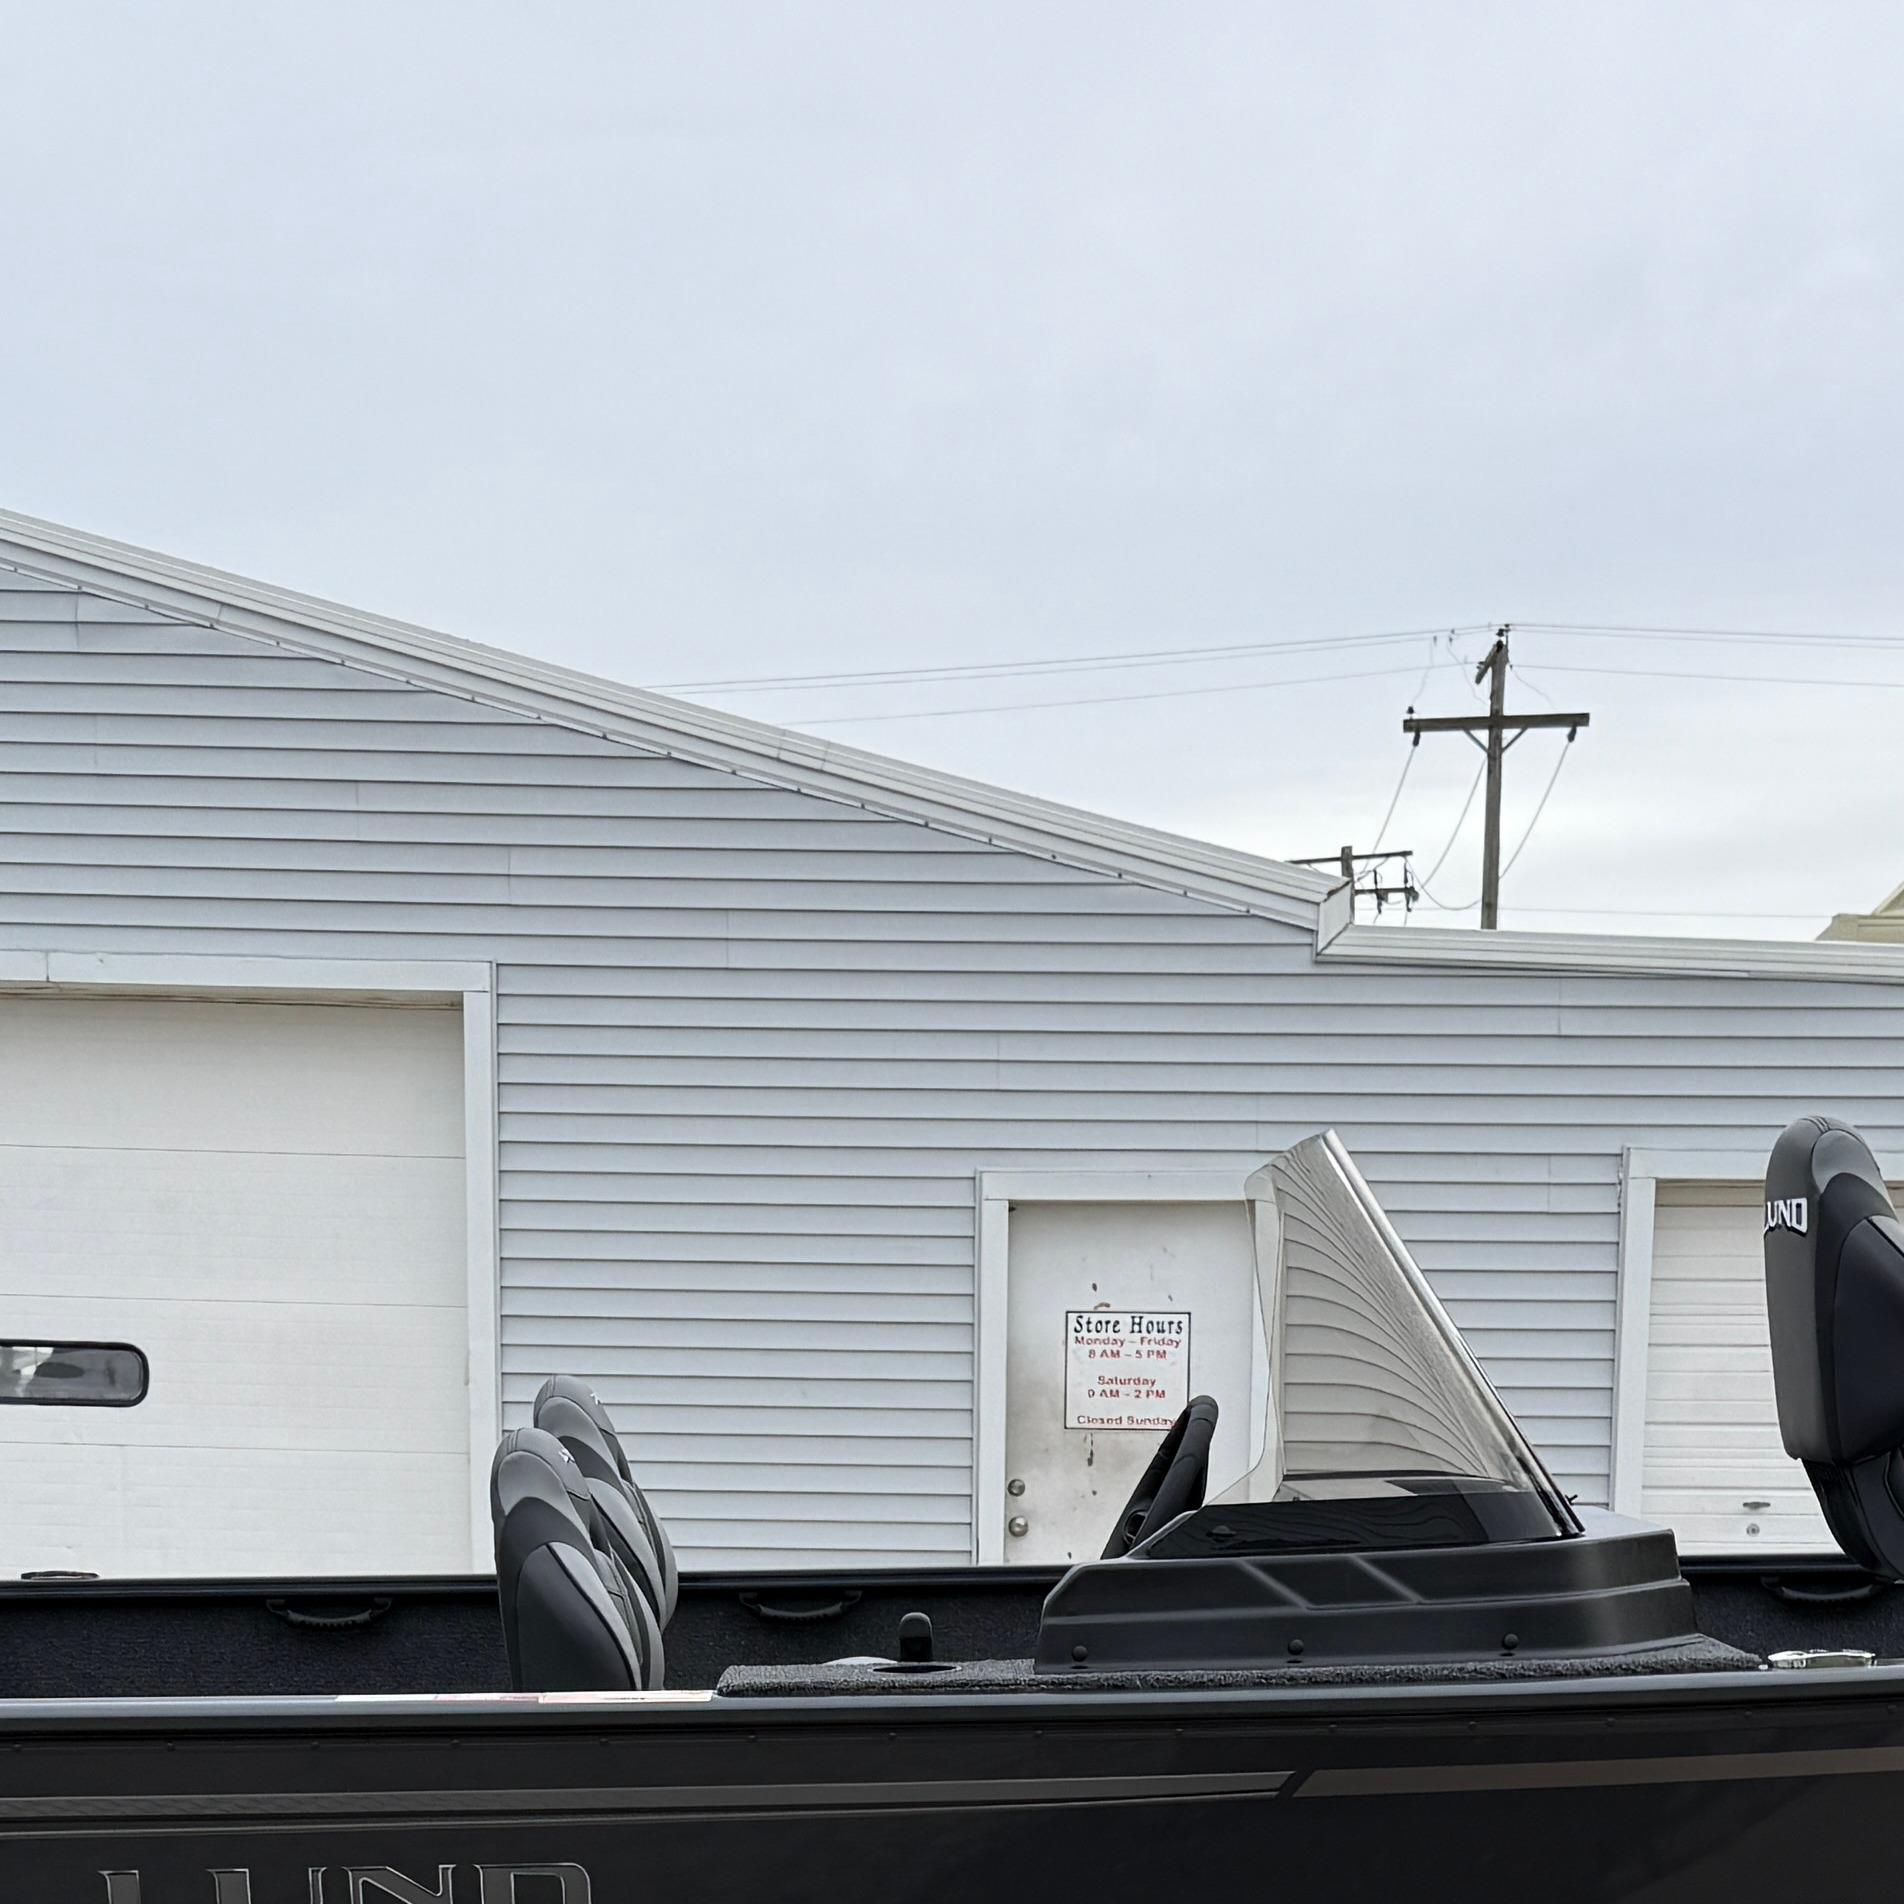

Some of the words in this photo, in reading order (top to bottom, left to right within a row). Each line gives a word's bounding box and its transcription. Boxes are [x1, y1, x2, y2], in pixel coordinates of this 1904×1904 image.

[1073, 1314, 1121, 1334] Store
[1129, 1315, 1184, 1335] Hours
[1074, 1335, 1126, 1348] Monday
[1139, 1336, 1182, 1349] Friday
[1088, 1348, 1096, 1359] 8
[1099, 1348, 1121, 1359] AM
[1134, 1349, 1143, 1359] 5
[1146, 1349, 1168, 1359] PM
[1096, 1374, 1157, 1390] Saturday
[1099, 1388, 1120, 1399] AM
[1133, 1389, 1142, 1399] 2
[1145, 1389, 1166, 1399] PM
[1076, 1414, 1123, 1425] Closed
